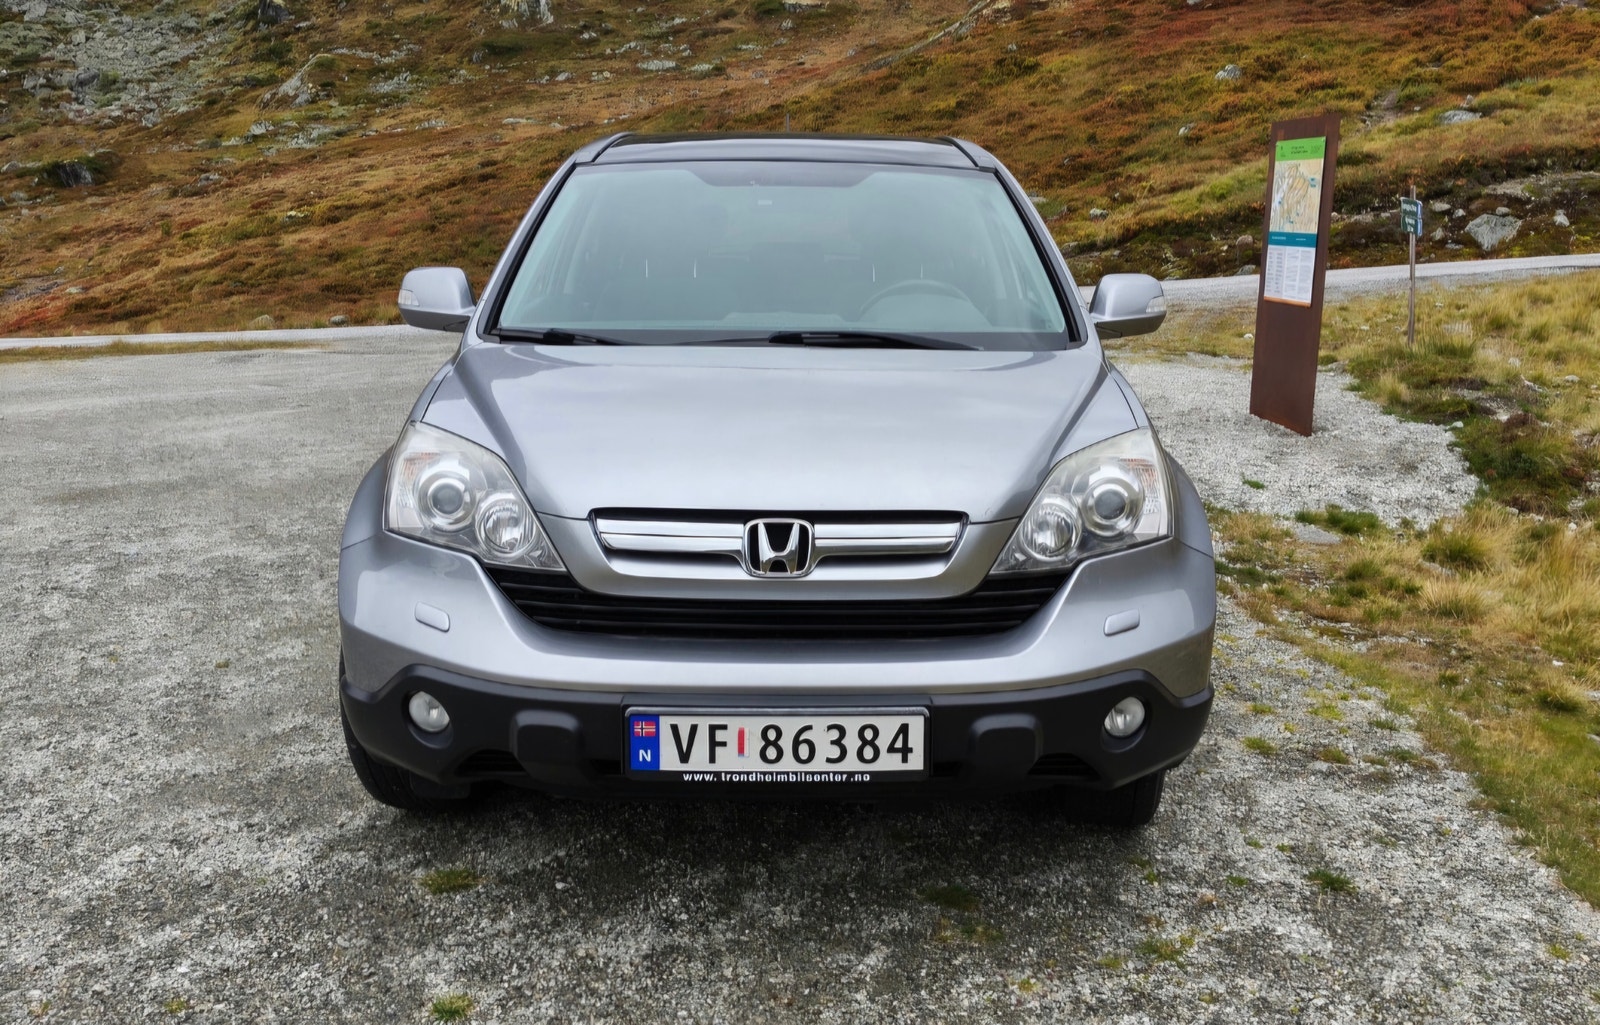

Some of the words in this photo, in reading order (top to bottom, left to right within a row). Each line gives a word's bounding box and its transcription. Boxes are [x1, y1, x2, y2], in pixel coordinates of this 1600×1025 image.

[638, 749, 652, 762] N
[669, 723, 729, 764] VF
[759, 722, 914, 765] 86384
